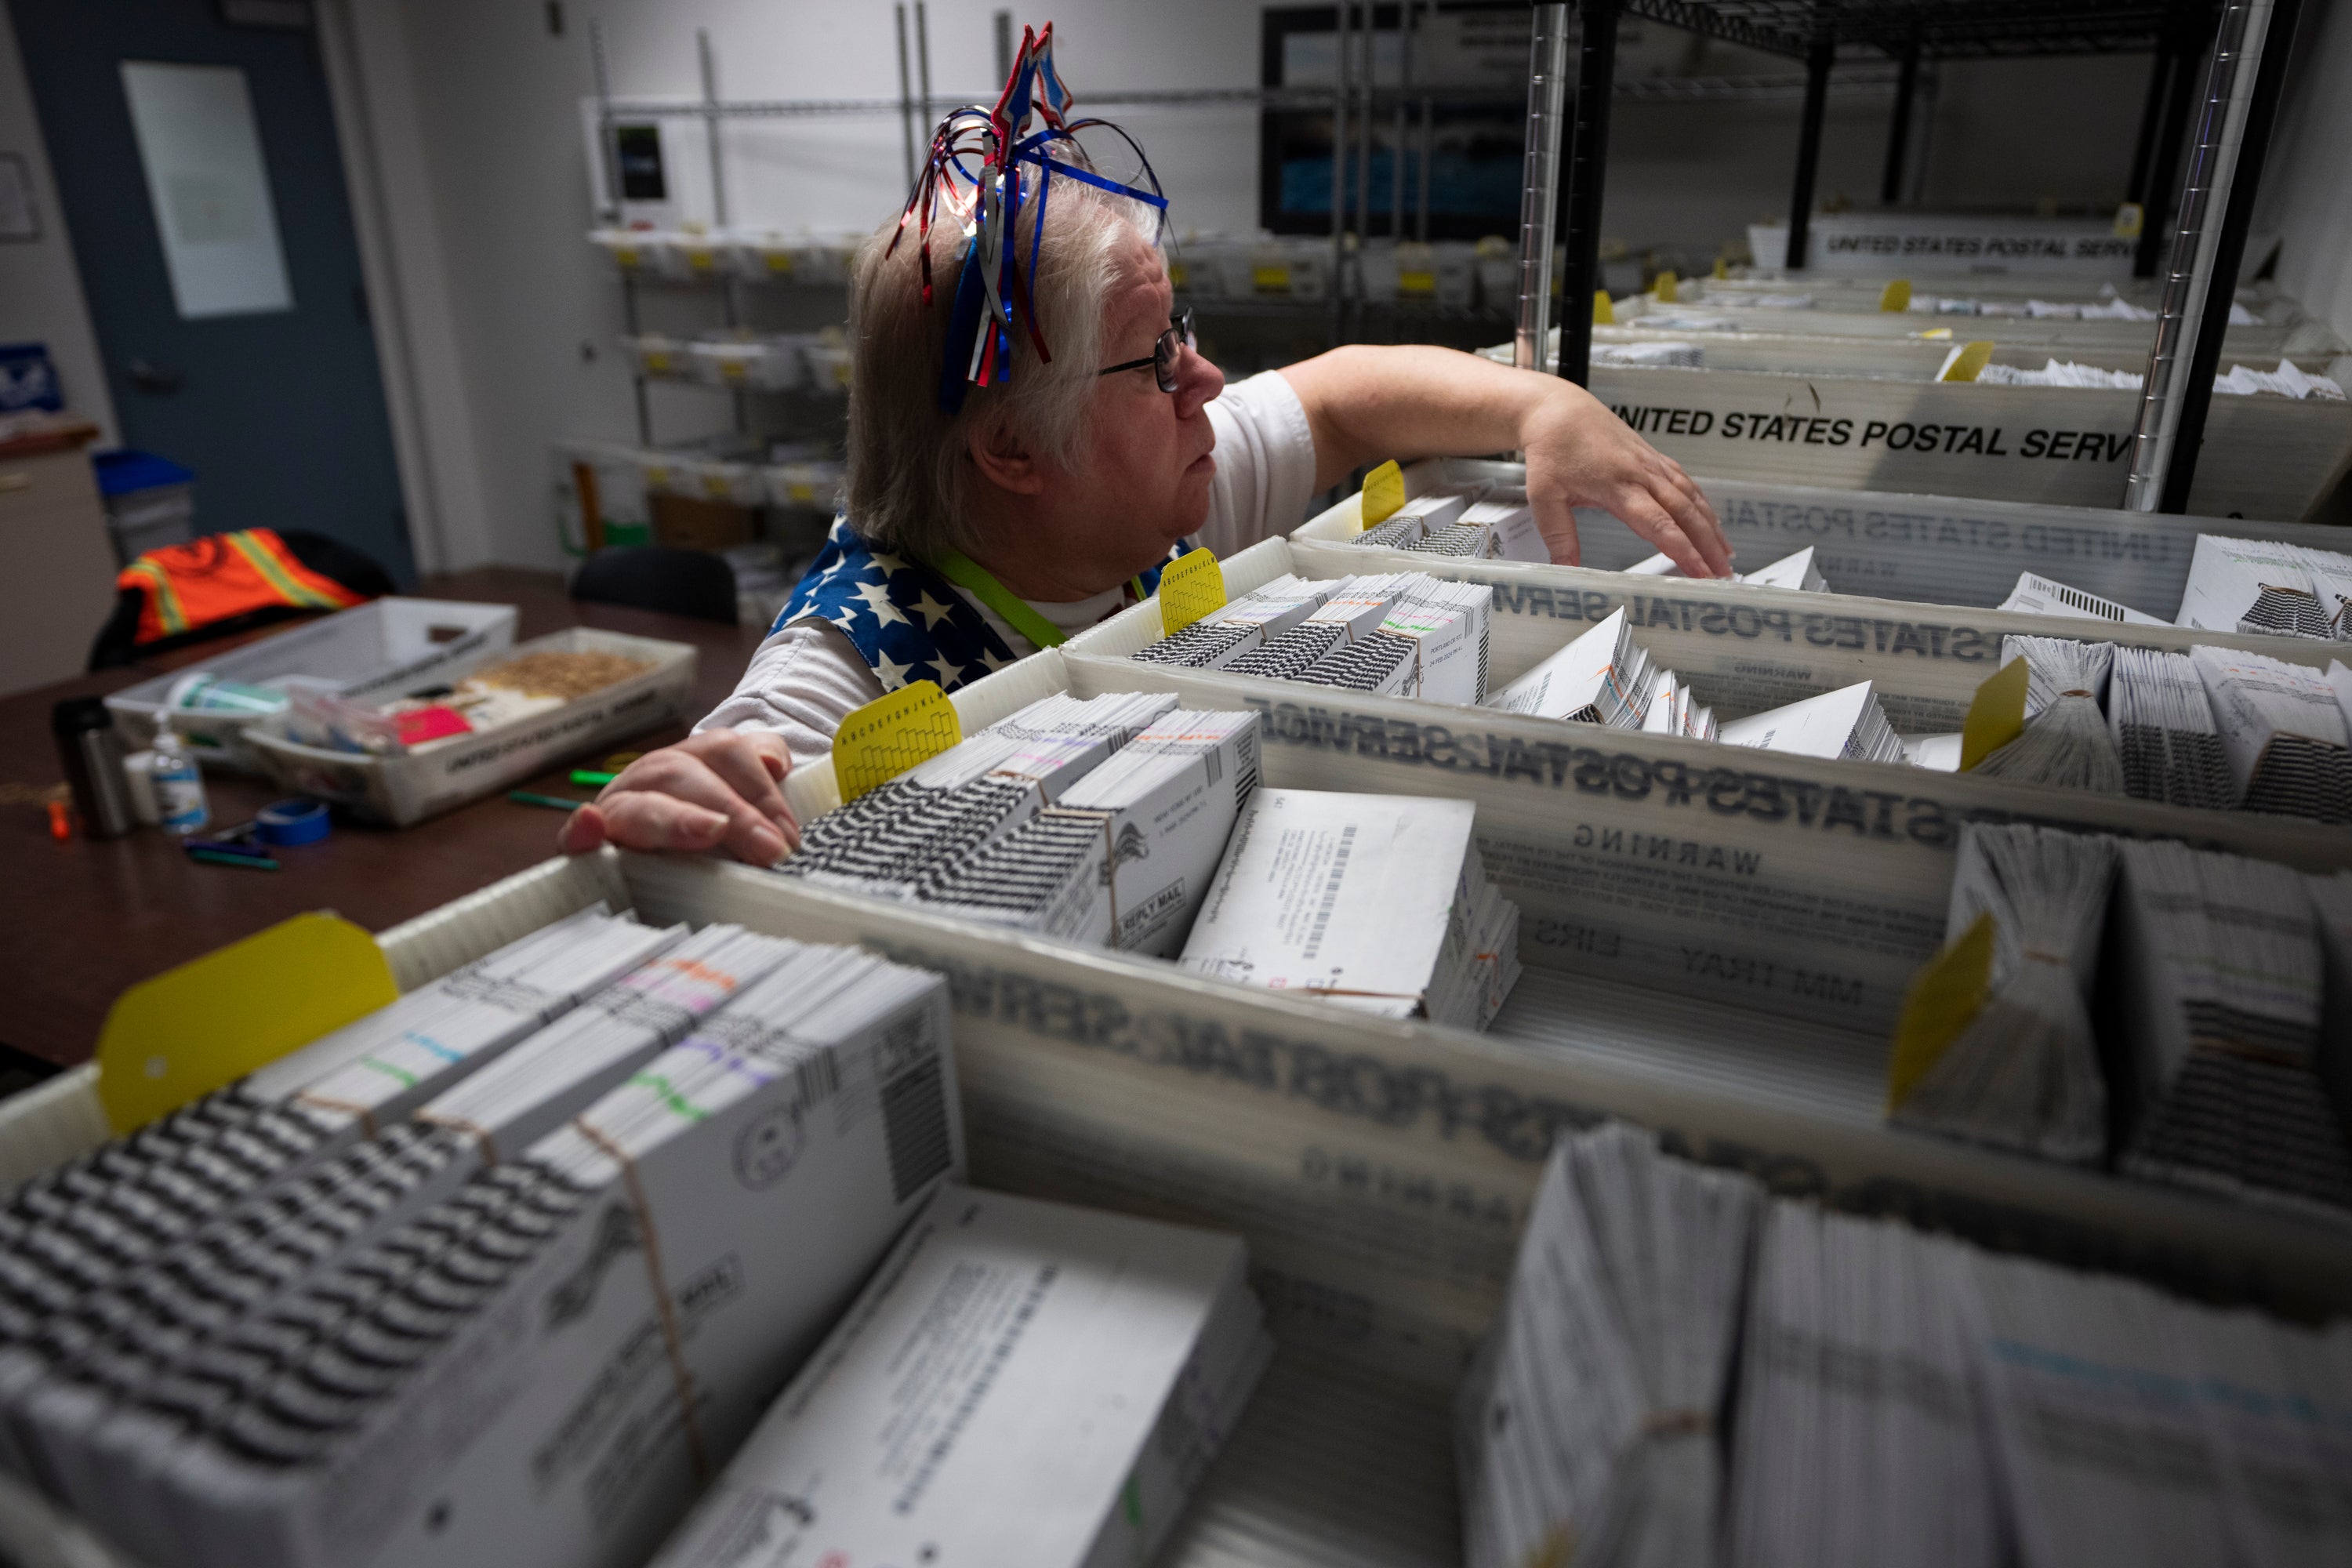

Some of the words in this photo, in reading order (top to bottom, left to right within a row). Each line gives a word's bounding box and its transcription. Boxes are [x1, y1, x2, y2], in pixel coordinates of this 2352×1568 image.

[1721, 412, 1854, 447] STATES
[1860, 420, 2008, 456] POSTAL
[2020, 429, 2134, 463] SERV
[1430, 640, 1450, 655] PORTLAND
[1435, 656, 1443, 665] FEB
[1123, 901, 1155, 929] REPLY
[1158, 886, 1181, 908] MAIL
